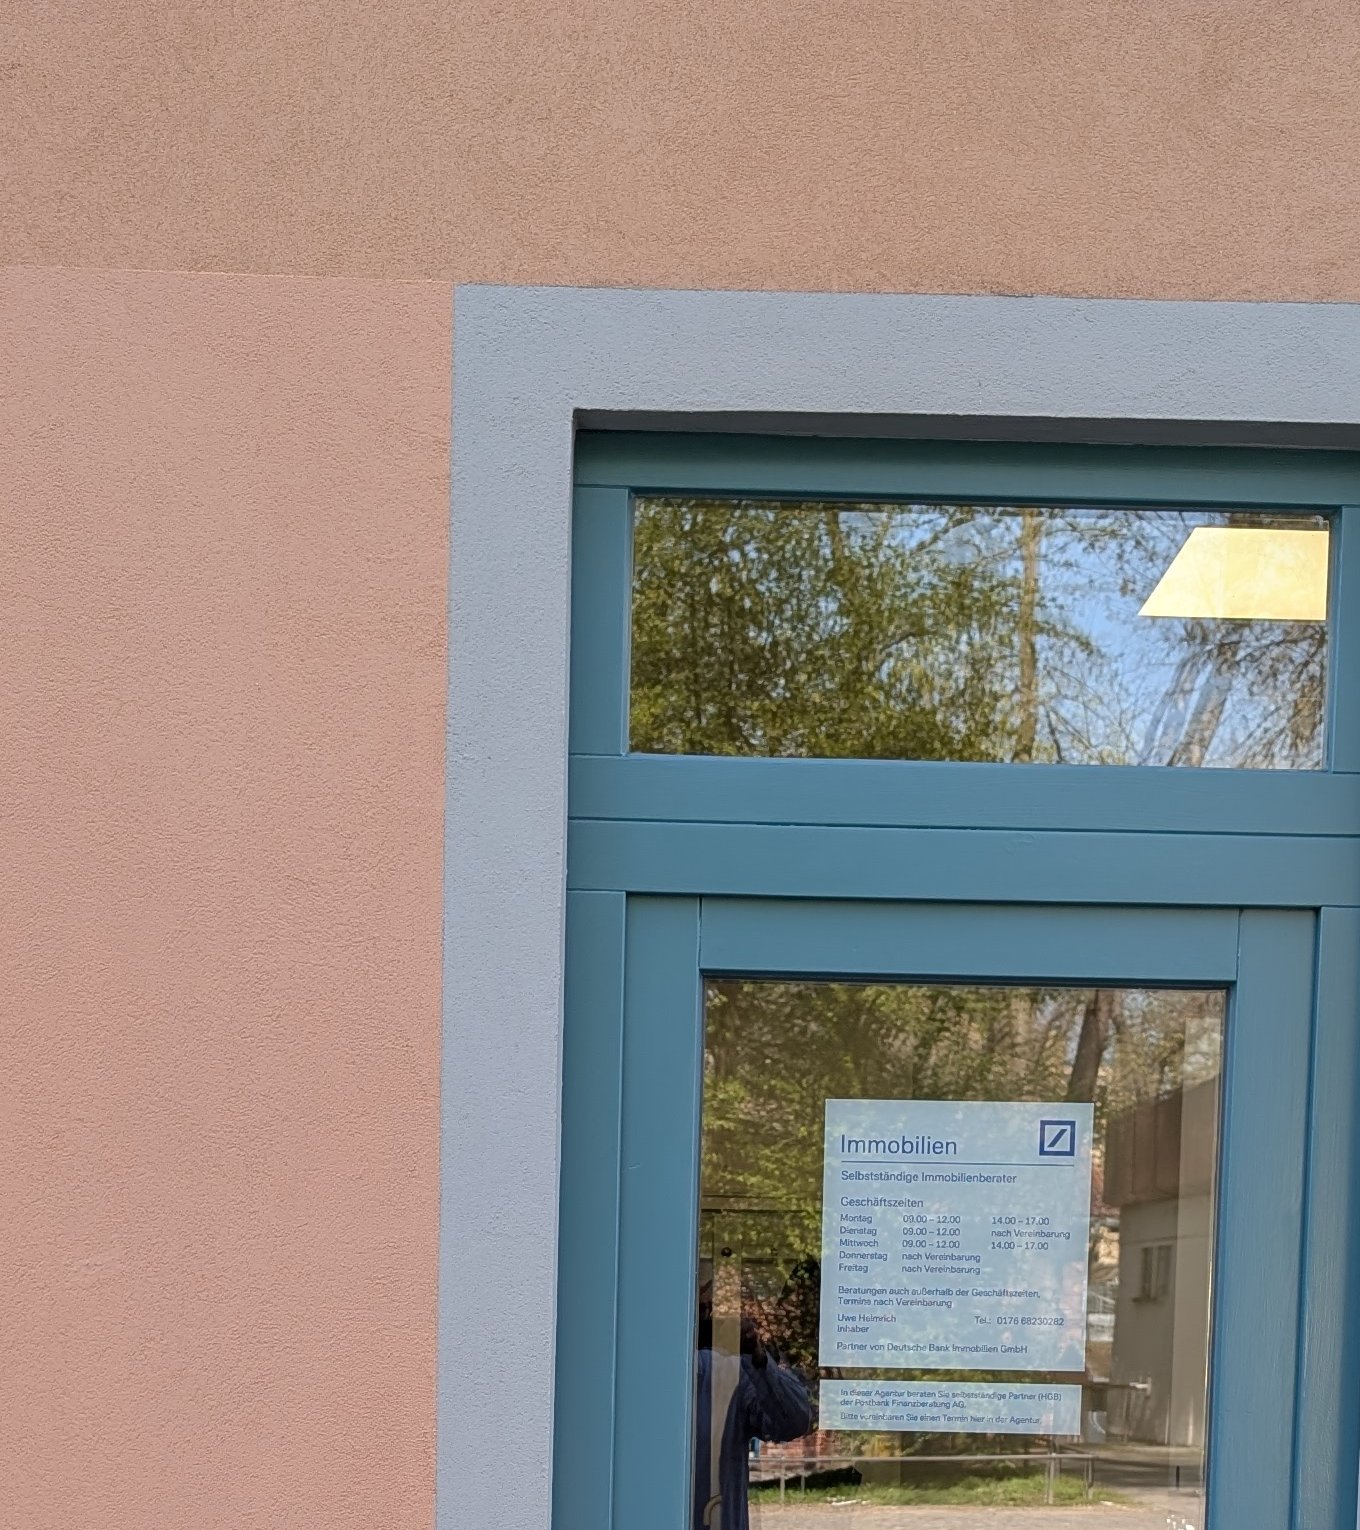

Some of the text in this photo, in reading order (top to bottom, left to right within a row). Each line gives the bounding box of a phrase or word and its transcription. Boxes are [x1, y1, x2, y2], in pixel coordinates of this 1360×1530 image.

[841, 1134, 957, 1155] Immobilien
[841, 1170, 1017, 1184] Selbstständige Immobilienberater
[840, 1196, 924, 1208] Geschäftszeiten
[840, 1214, 1050, 1225] Montag 09.00 12.00 14.00 17.00
[840, 1226, 1070, 1240] Dienstag 09.00 12.00 nach Vereinbarung
[840, 1239, 1049, 1250] Mittwoch 09.00 12.00 14.00 17.00
[839, 1251, 980, 1263] Donnerstag nach Vereinbarung
[839, 1263, 980, 1275] Freitag nach Vereinbarung
[838, 1286, 969, 1296] Beratungen auch außerhalb der
[838, 1297, 952, 1308] Termine nach Vereinbarung
[997, 1317, 1019, 1325] 0176
[837, 1325, 869, 1333] Inhaber
[837, 1342, 867, 1350] Partner
[887, 1343, 926, 1351] Deutsche
[952, 1344, 998, 1352] Immobilien
[1000, 1345, 1027, 1353] GmbH
[1009, 1392, 1036, 1400] Partner
[1038, 1393, 1062, 1401] (HGB)
